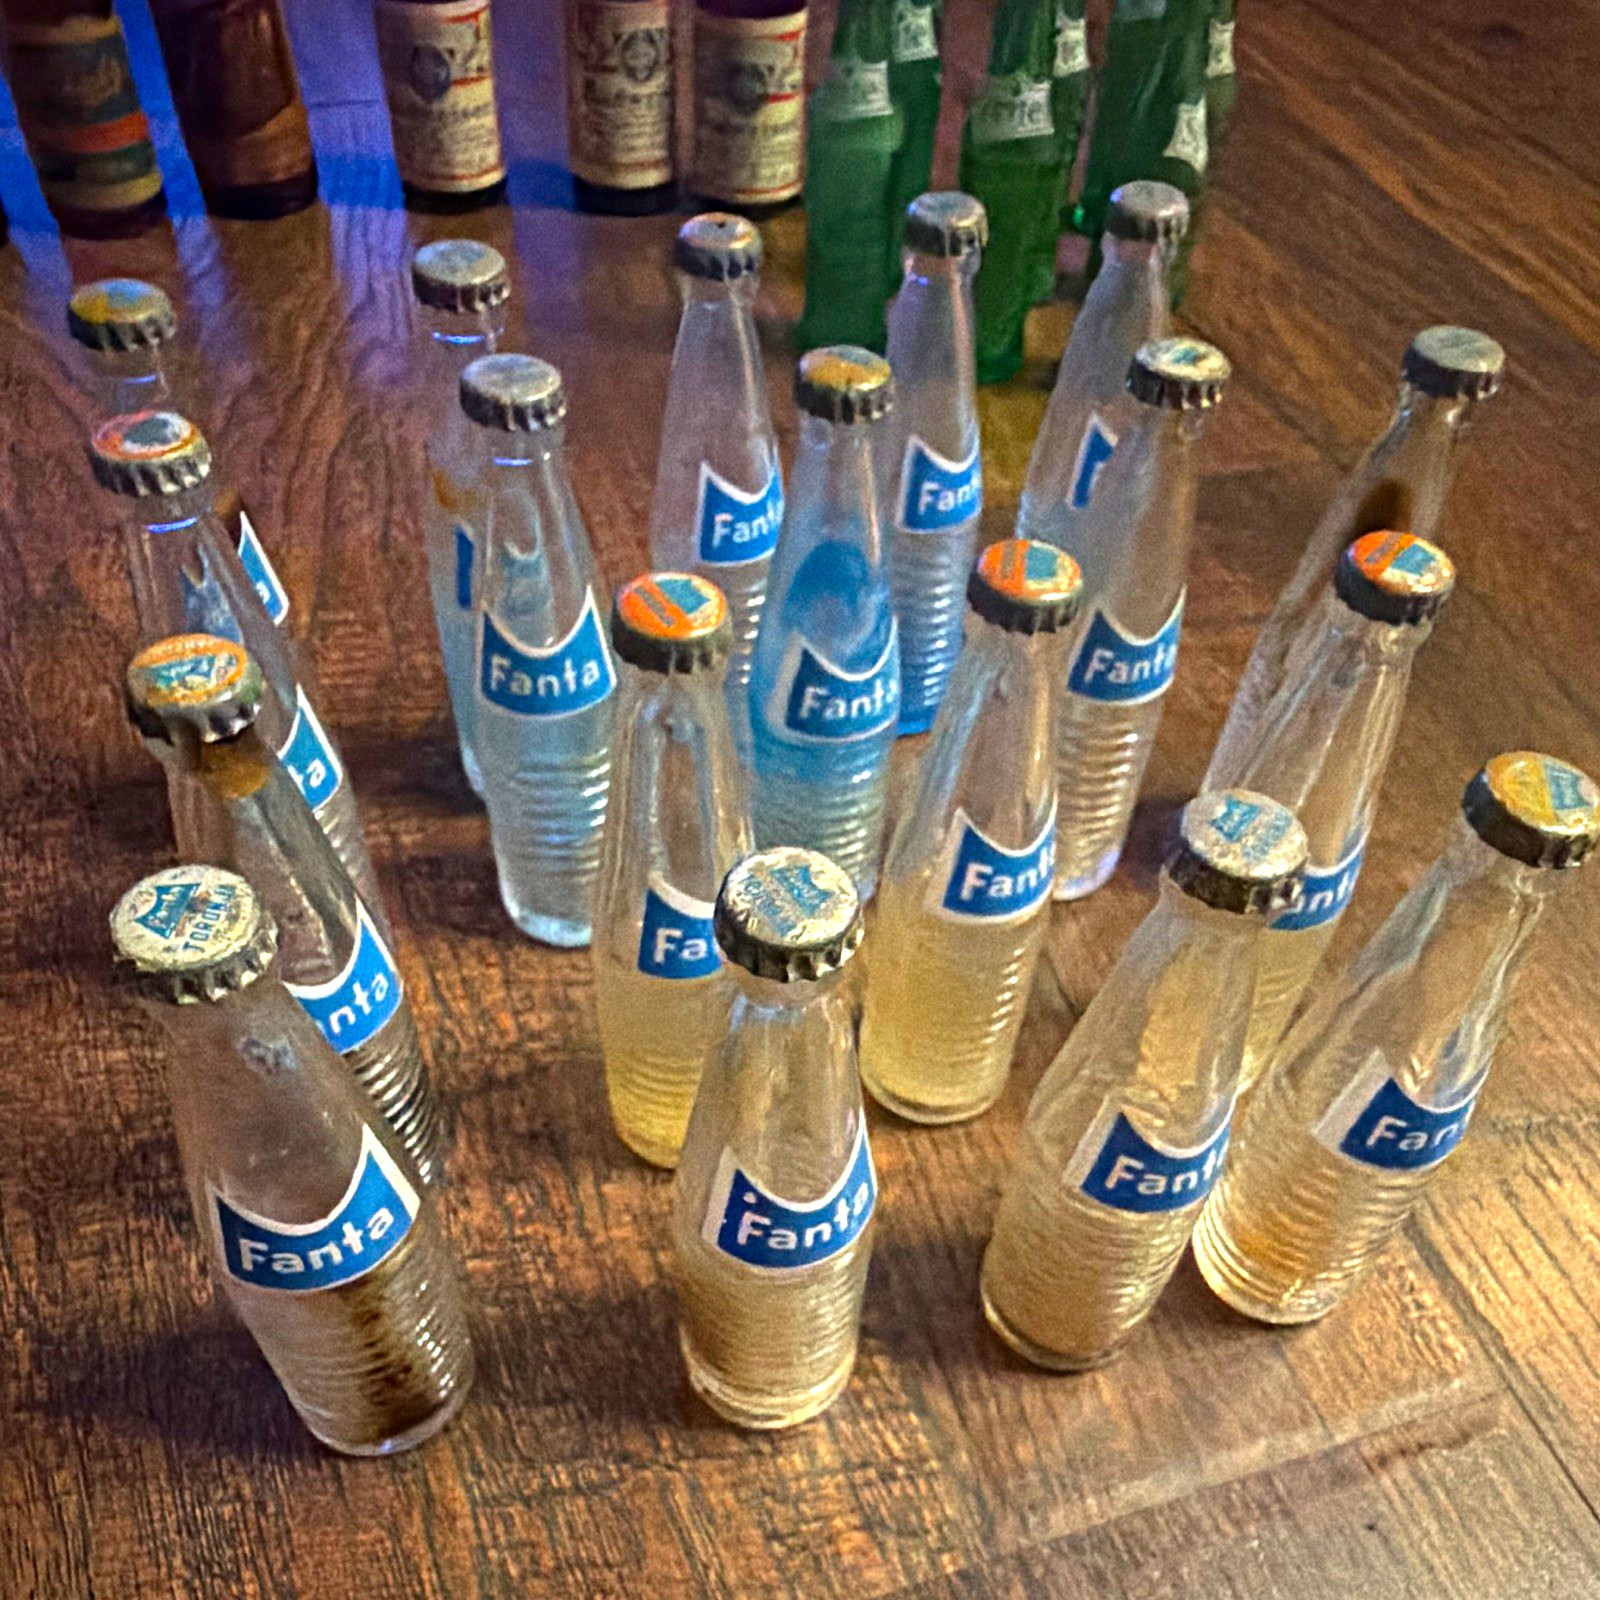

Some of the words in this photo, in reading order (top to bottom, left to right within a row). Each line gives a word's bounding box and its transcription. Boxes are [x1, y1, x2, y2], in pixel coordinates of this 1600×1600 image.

[918, 469, 980, 515] Fant
[489, 655, 600, 698] Fanta
[329, 972, 389, 1036] nta
[1366, 1115, 1460, 1147] Fan
[1105, 1142, 1229, 1195] Fant
[239, 1207, 395, 1275] Fanta
[737, 1182, 869, 1250] Fanta
